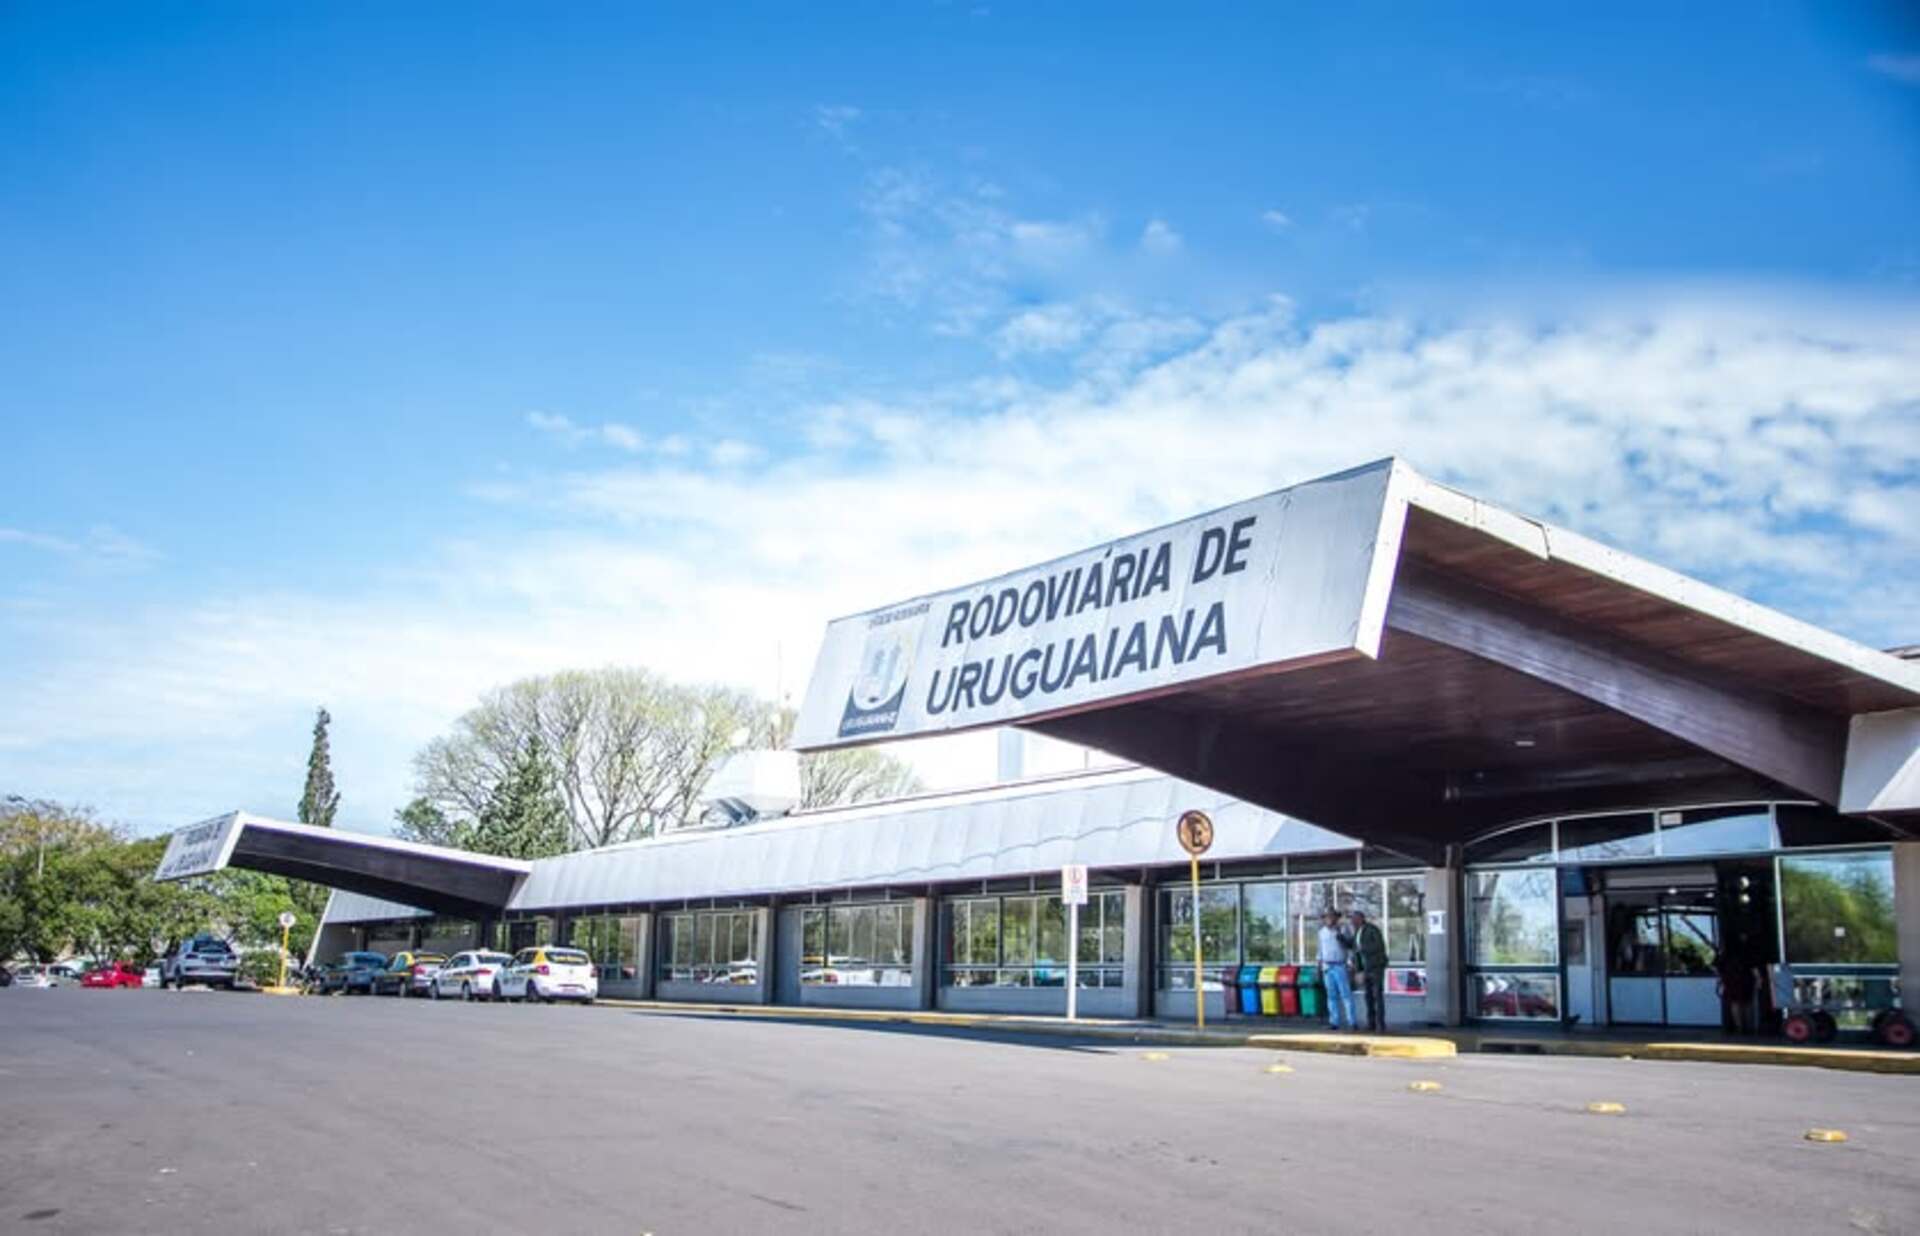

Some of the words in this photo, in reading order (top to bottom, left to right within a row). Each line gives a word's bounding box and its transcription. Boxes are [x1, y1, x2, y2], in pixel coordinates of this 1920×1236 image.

[942, 541, 1172, 647] RODOVIÁRIA
[1193, 517, 1256, 584] DE
[927, 602, 1227, 715] URUGUAIANA
